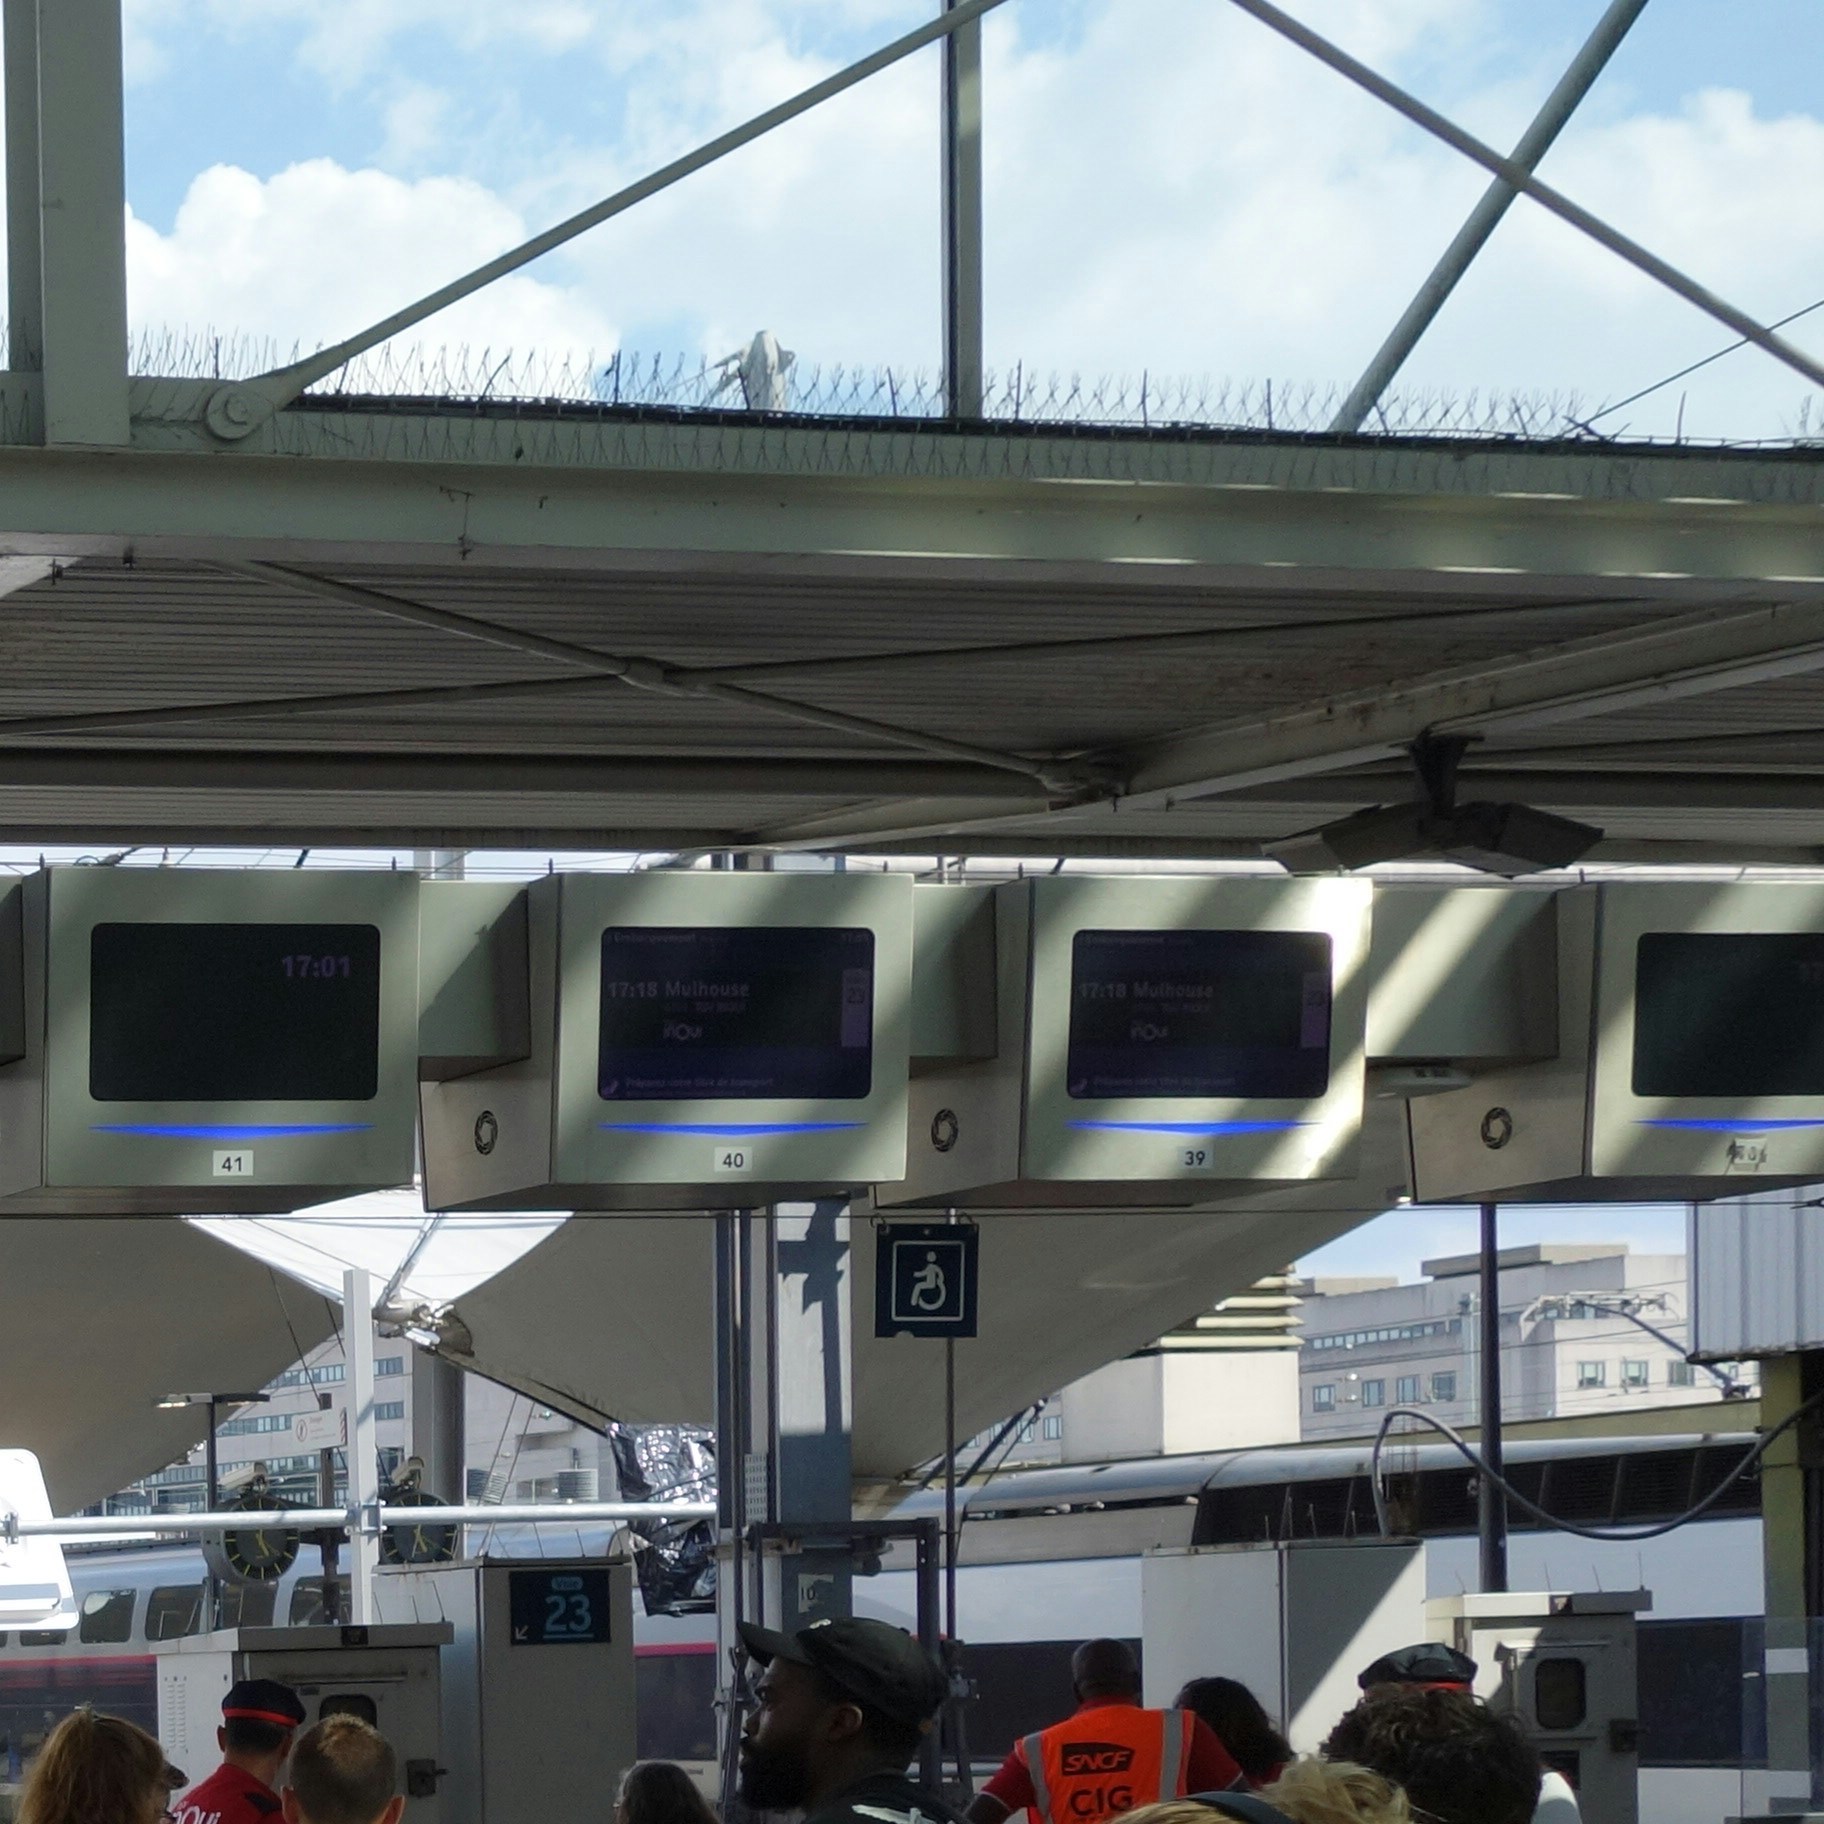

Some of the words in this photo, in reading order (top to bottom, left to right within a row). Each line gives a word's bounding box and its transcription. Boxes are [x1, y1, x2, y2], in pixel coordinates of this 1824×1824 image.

[282, 955, 351, 977] 17:01
[609, 982, 657, 997] 17:18
[665, 981, 749, 997] Mulhouse
[221, 1156, 242, 1172] 41
[722, 1152, 744, 1169] 40
[1184, 1150, 1206, 1167] 39
[545, 1594, 591, 1632] 23
[1064, 1751, 1131, 1772] SNCF
[1070, 1785, 1133, 1816] CIG
